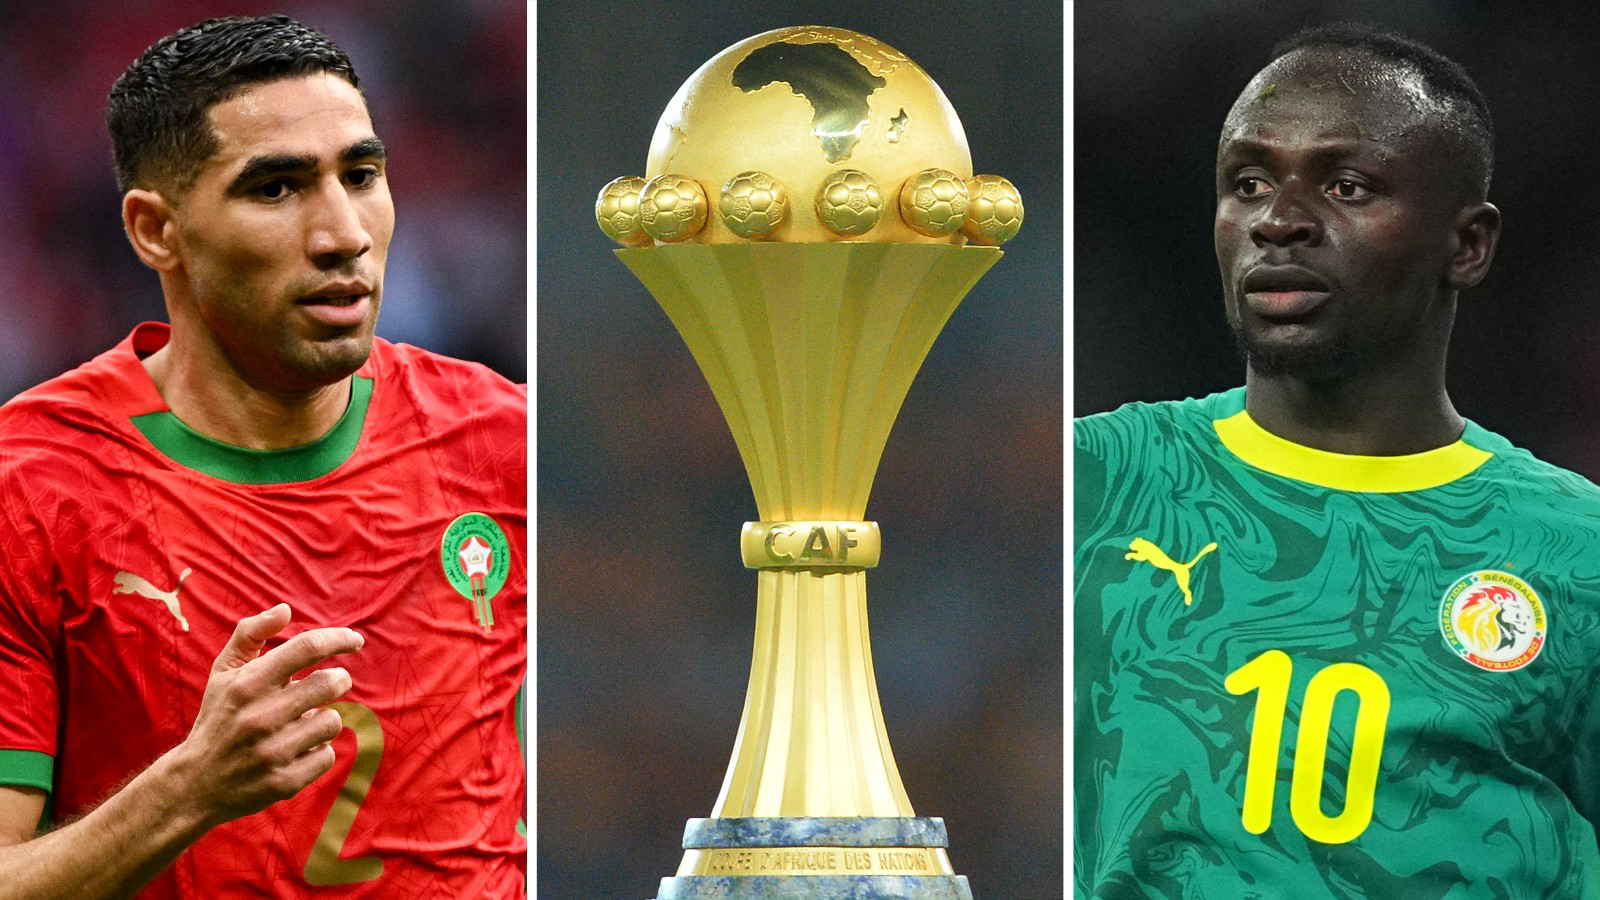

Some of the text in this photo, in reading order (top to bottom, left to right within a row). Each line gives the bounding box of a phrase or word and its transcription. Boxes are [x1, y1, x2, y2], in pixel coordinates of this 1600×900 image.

[764, 524, 858, 562] CAF
[1443, 574, 1542, 645] FÉDÉRATION SÉNÉGALAISE
[1476, 641, 1539, 669] DE FOOTBALL
[1224, 649, 1391, 845] 10
[303, 701, 385, 887] 2
[760, 851, 837, 871] D'AFRIQUE
[844, 851, 873, 870] DES
[878, 851, 928, 871] NATIONS
